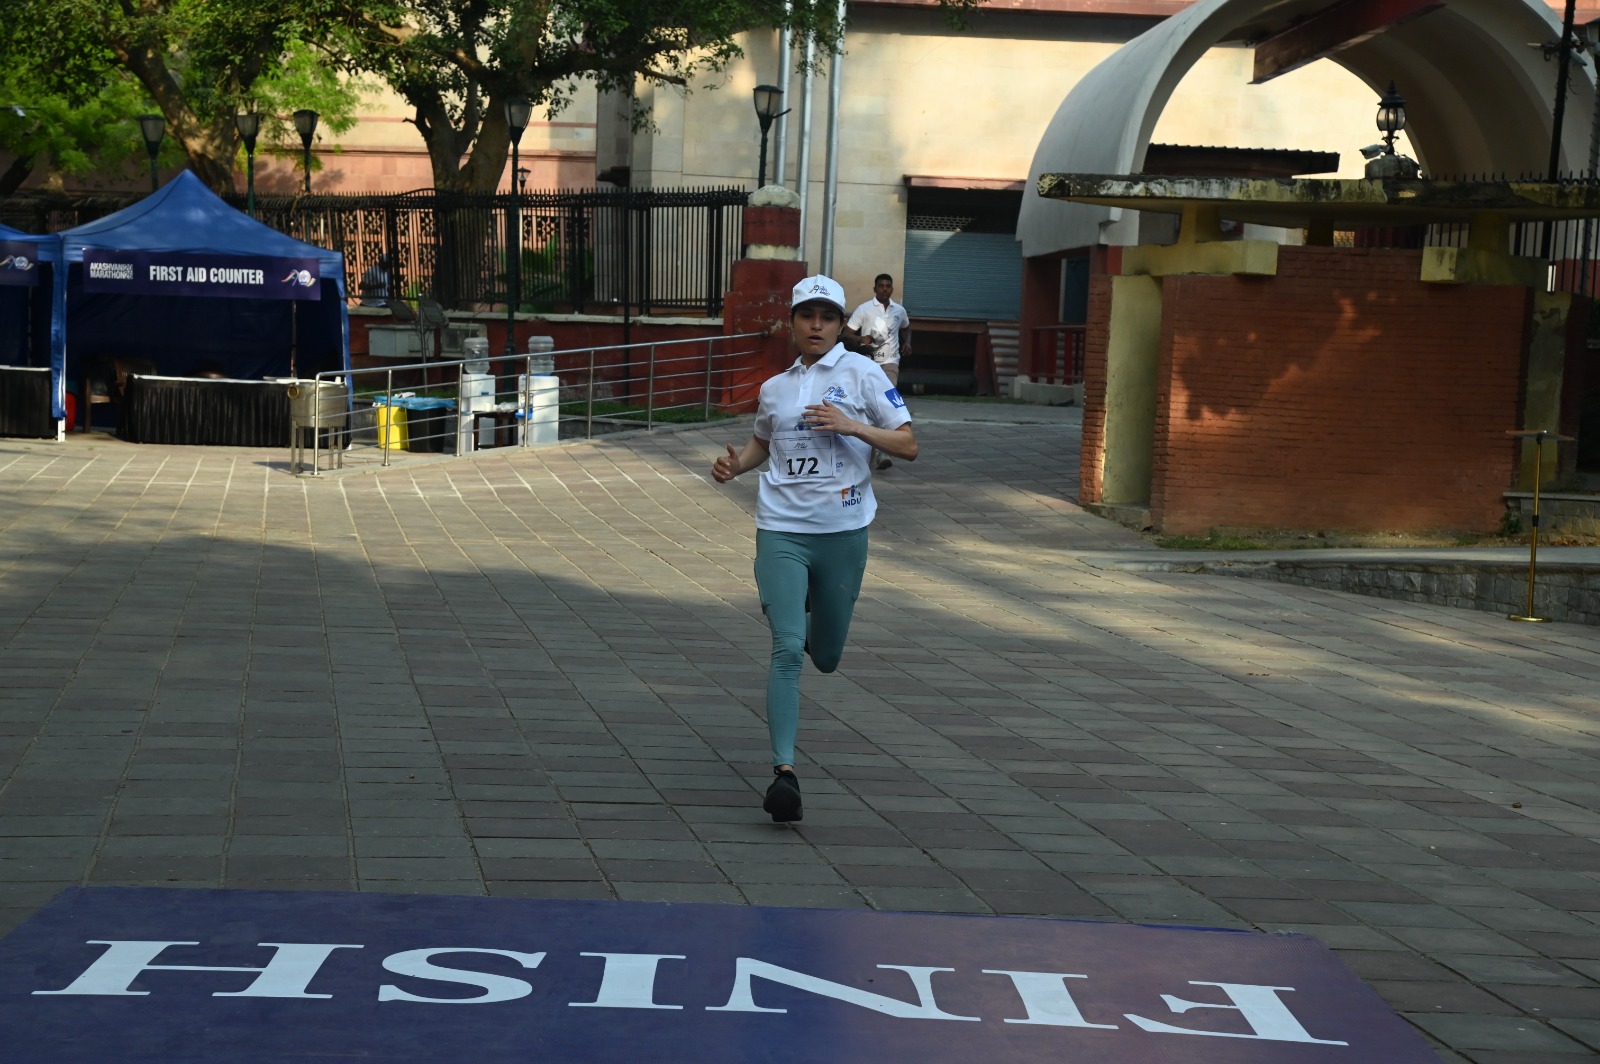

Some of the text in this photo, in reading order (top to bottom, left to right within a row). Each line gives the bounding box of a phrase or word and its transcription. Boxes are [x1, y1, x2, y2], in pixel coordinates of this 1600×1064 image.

[90, 270, 126, 279] MARATHON
[149, 265, 183, 282] FIRST
[186, 267, 207, 282] AID
[209, 268, 264, 285] COUNTER
[786, 457, 820, 475] 172
[31, 940, 1349, 1047] FINISH
